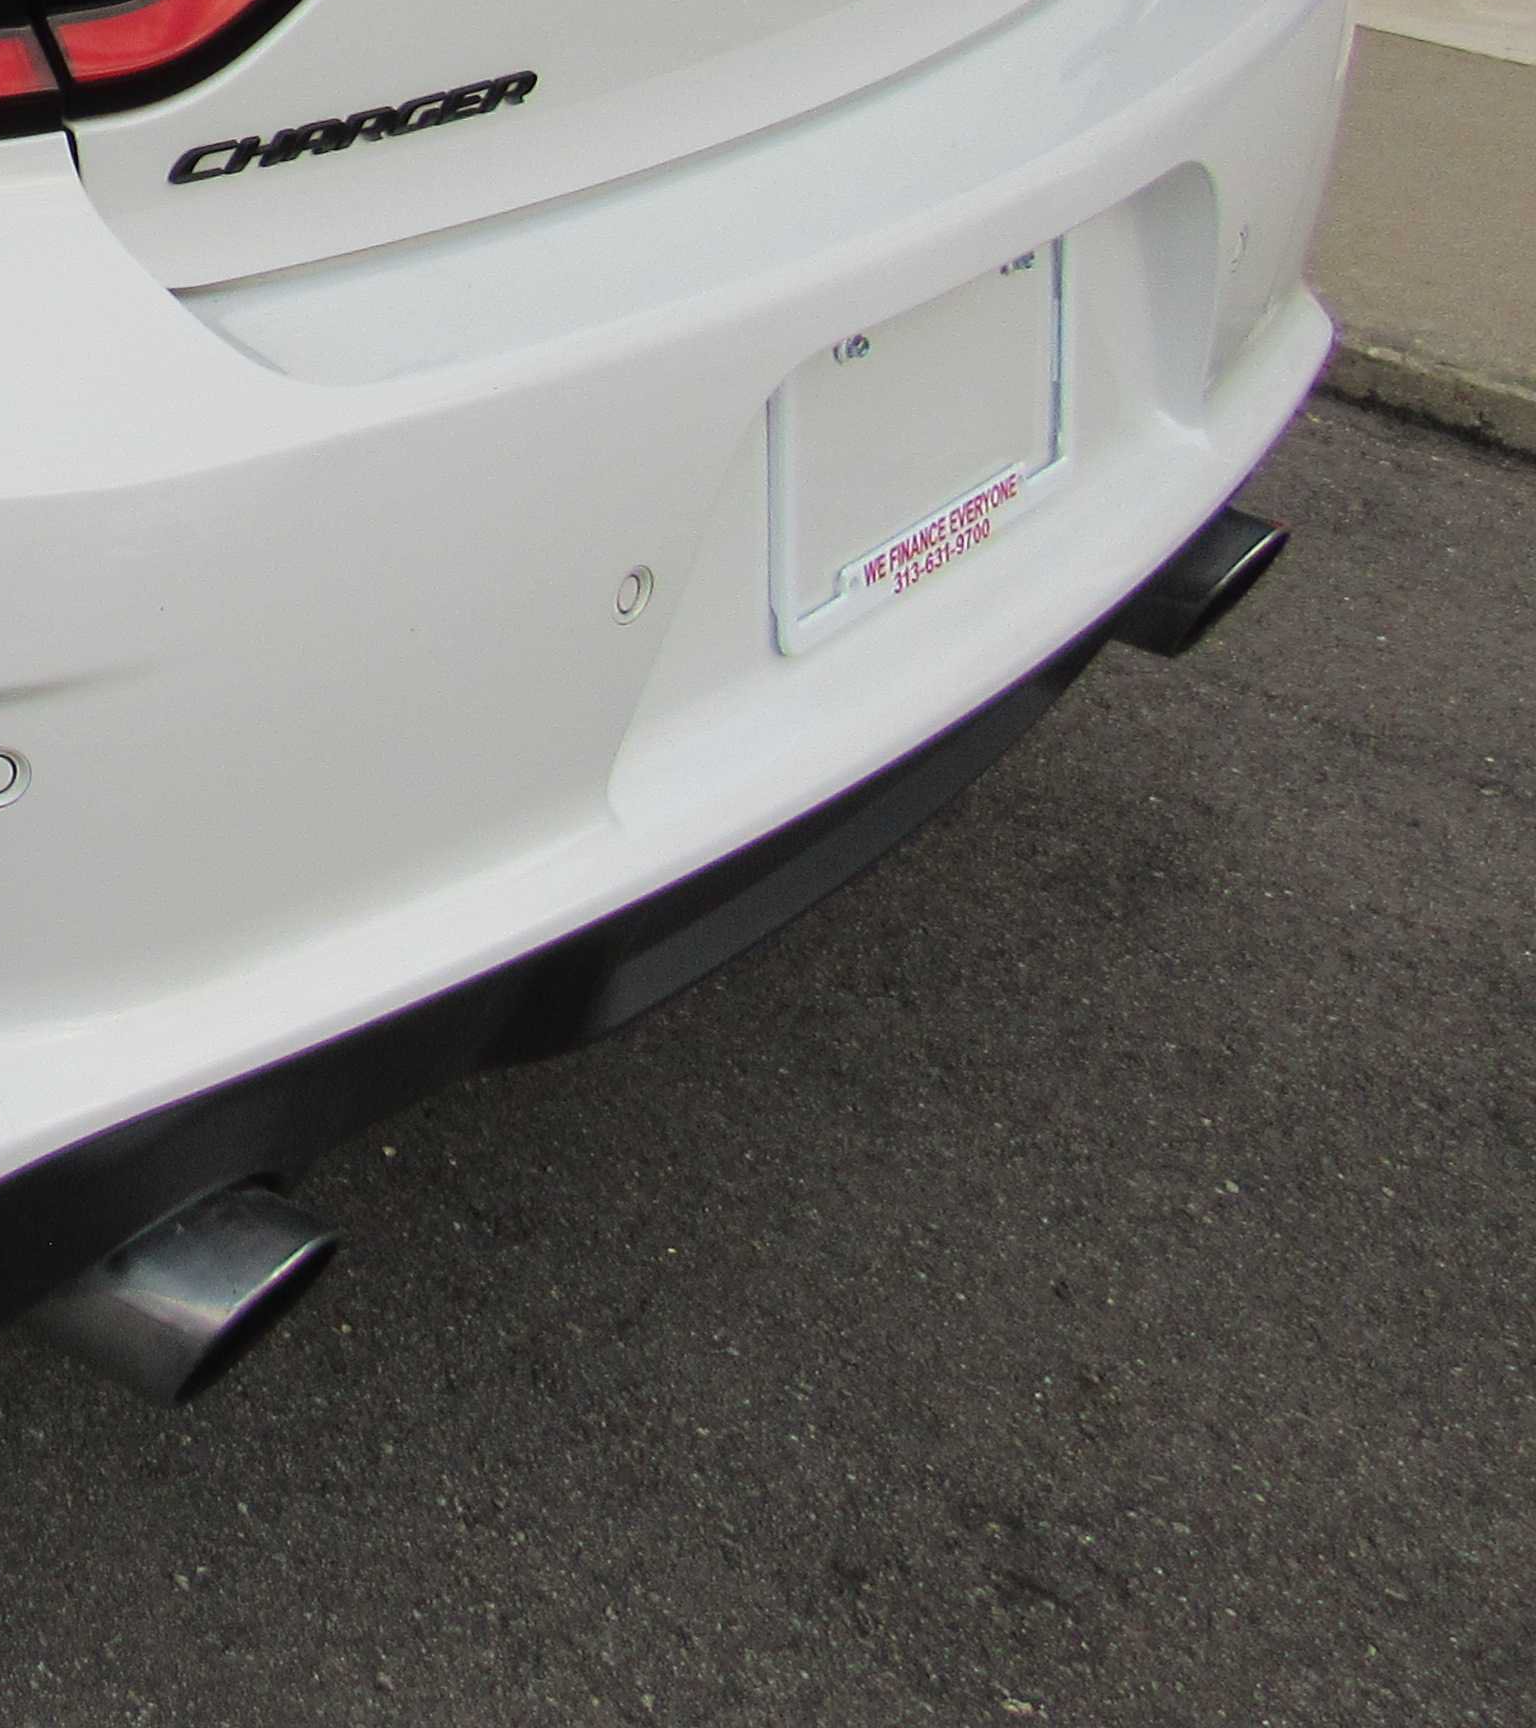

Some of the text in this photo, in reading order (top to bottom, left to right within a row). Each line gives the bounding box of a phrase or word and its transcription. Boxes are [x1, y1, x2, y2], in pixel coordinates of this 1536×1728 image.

[167, 70, 538, 185] CHARGER
[863, 474, 1018, 587] WE FINANCE EVERYONE
[893, 518, 991, 594] 313-631-9700
